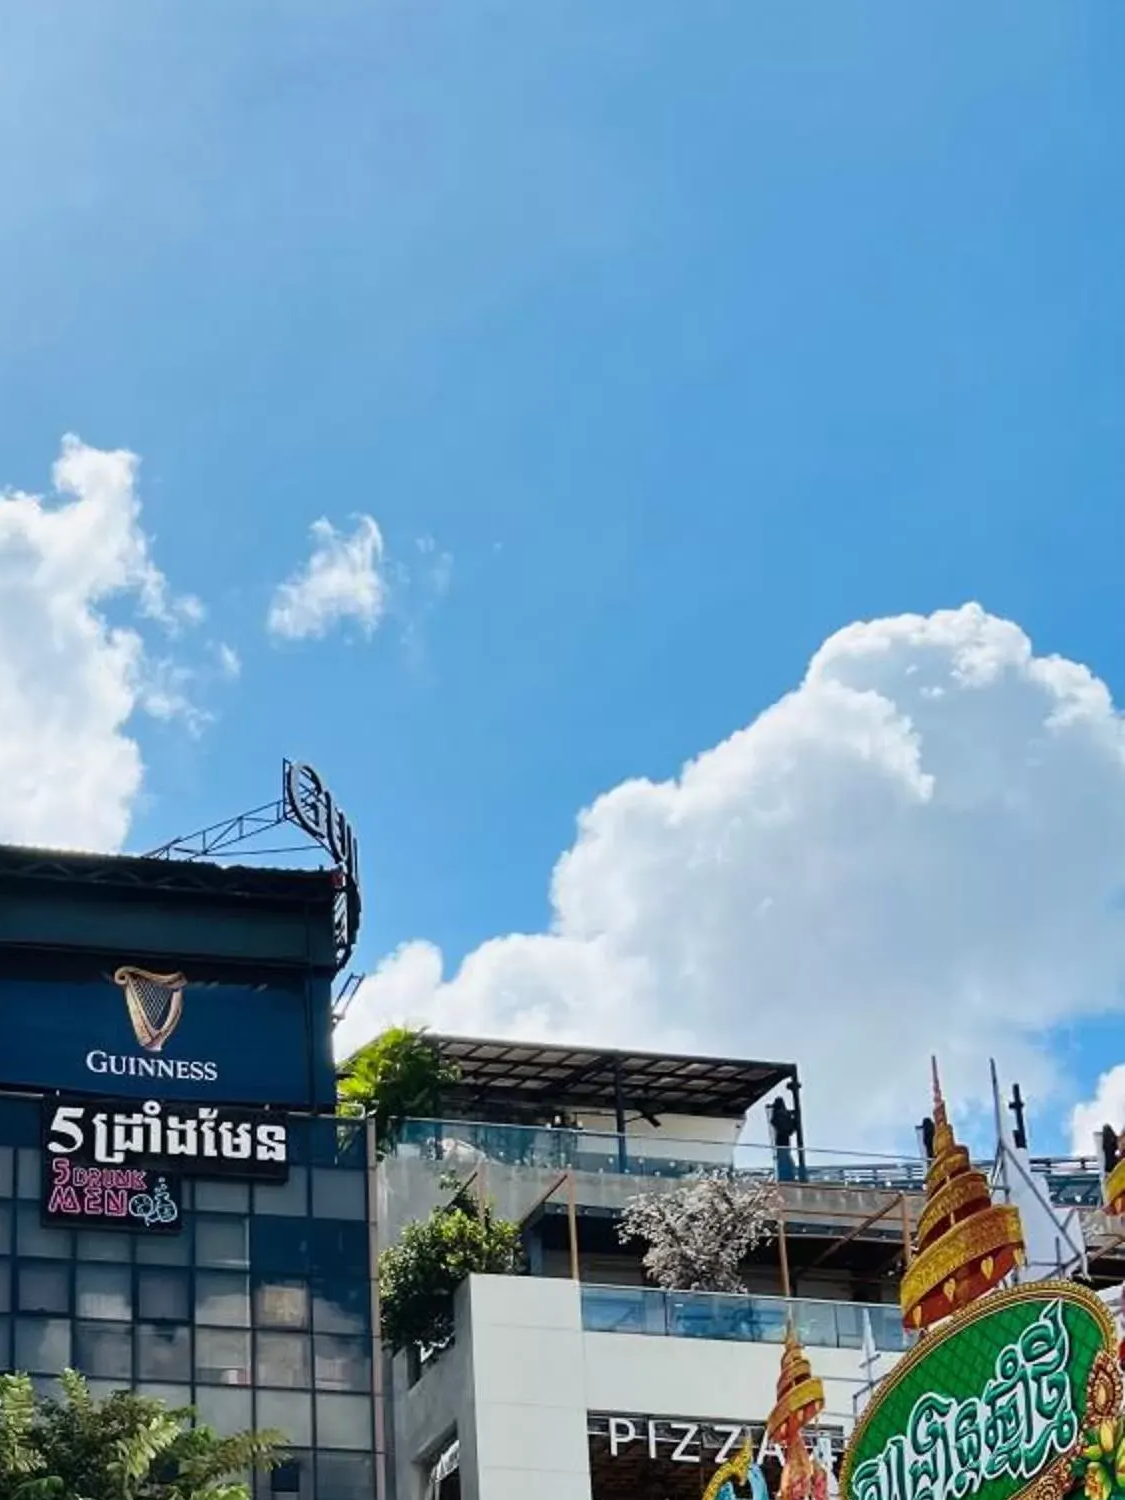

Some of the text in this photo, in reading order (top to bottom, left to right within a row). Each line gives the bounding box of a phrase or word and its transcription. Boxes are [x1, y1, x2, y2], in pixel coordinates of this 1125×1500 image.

[85, 1050, 218, 1082] GUINNESS
[47, 1106, 86, 1154] 5
[51, 1156, 148, 1191] 5 DRUNK
[47, 1185, 128, 1217] MEN
